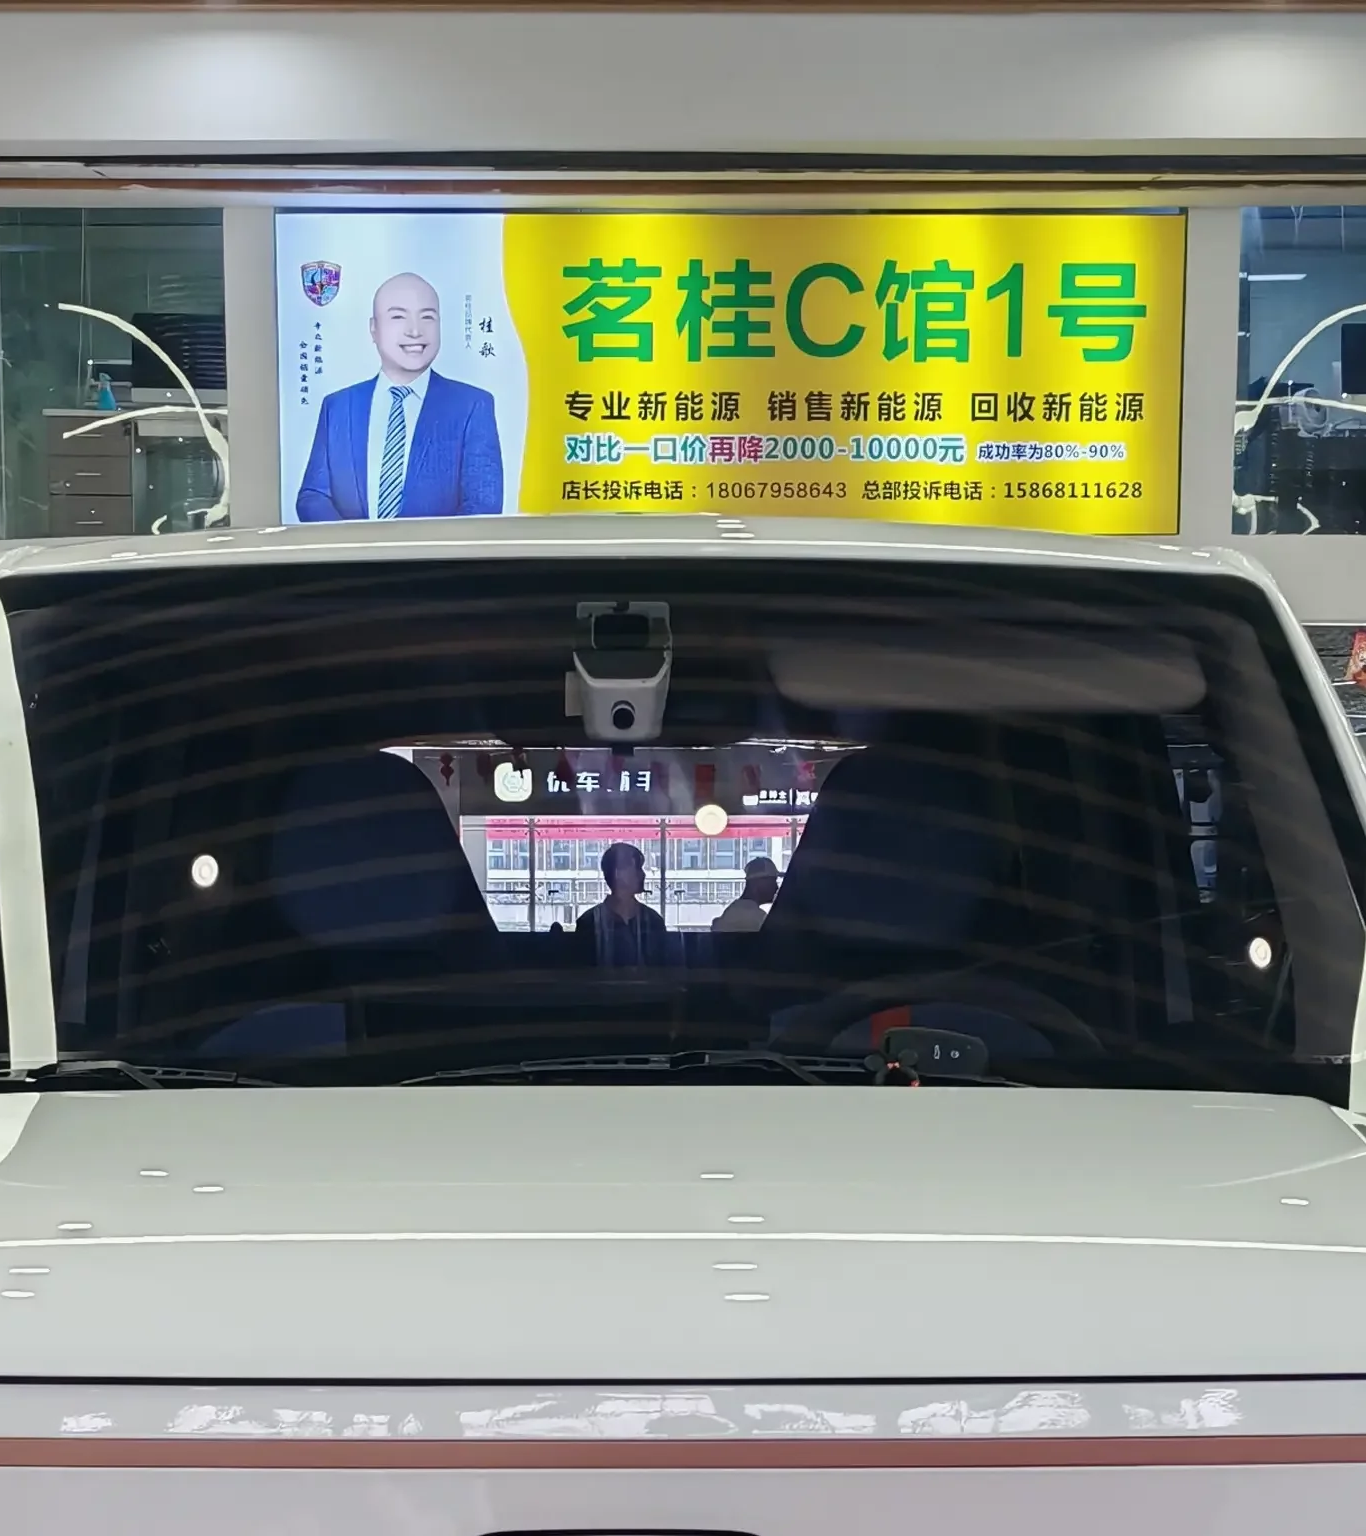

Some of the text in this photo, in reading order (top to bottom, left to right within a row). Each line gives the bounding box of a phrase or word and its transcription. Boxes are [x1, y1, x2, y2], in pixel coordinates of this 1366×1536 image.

[561, 257, 1148, 365] 茗桂C馆1号
[564, 390, 1145, 423] 专业新能源 销售新能源 回收新能源
[565, 434, 1125, 464] 对比一口价再降2000-10000元 成功率为80%-90%
